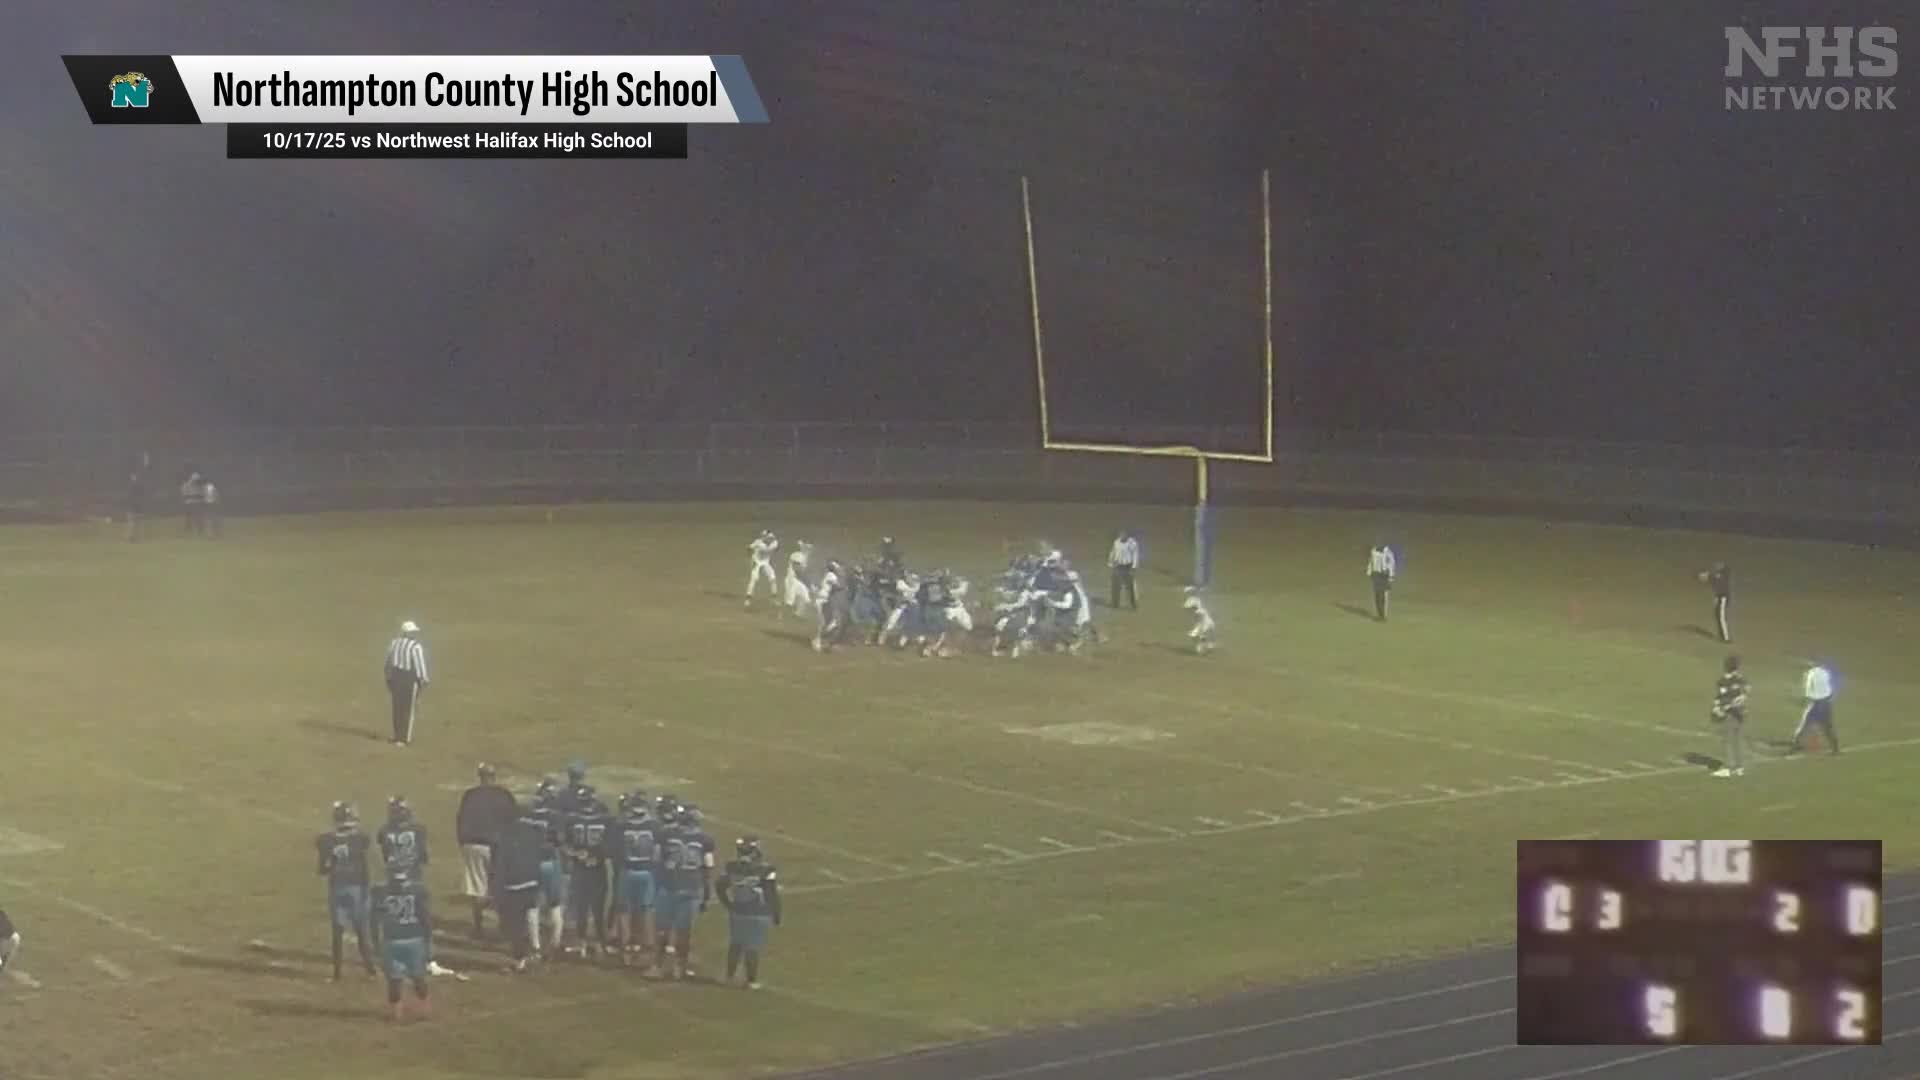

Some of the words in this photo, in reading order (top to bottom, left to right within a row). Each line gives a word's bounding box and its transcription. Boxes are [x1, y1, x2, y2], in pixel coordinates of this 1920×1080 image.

[1598, 891, 1622, 930] 3
[1774, 892, 1799, 932] 2
[1837, 990, 1865, 1039] 2
